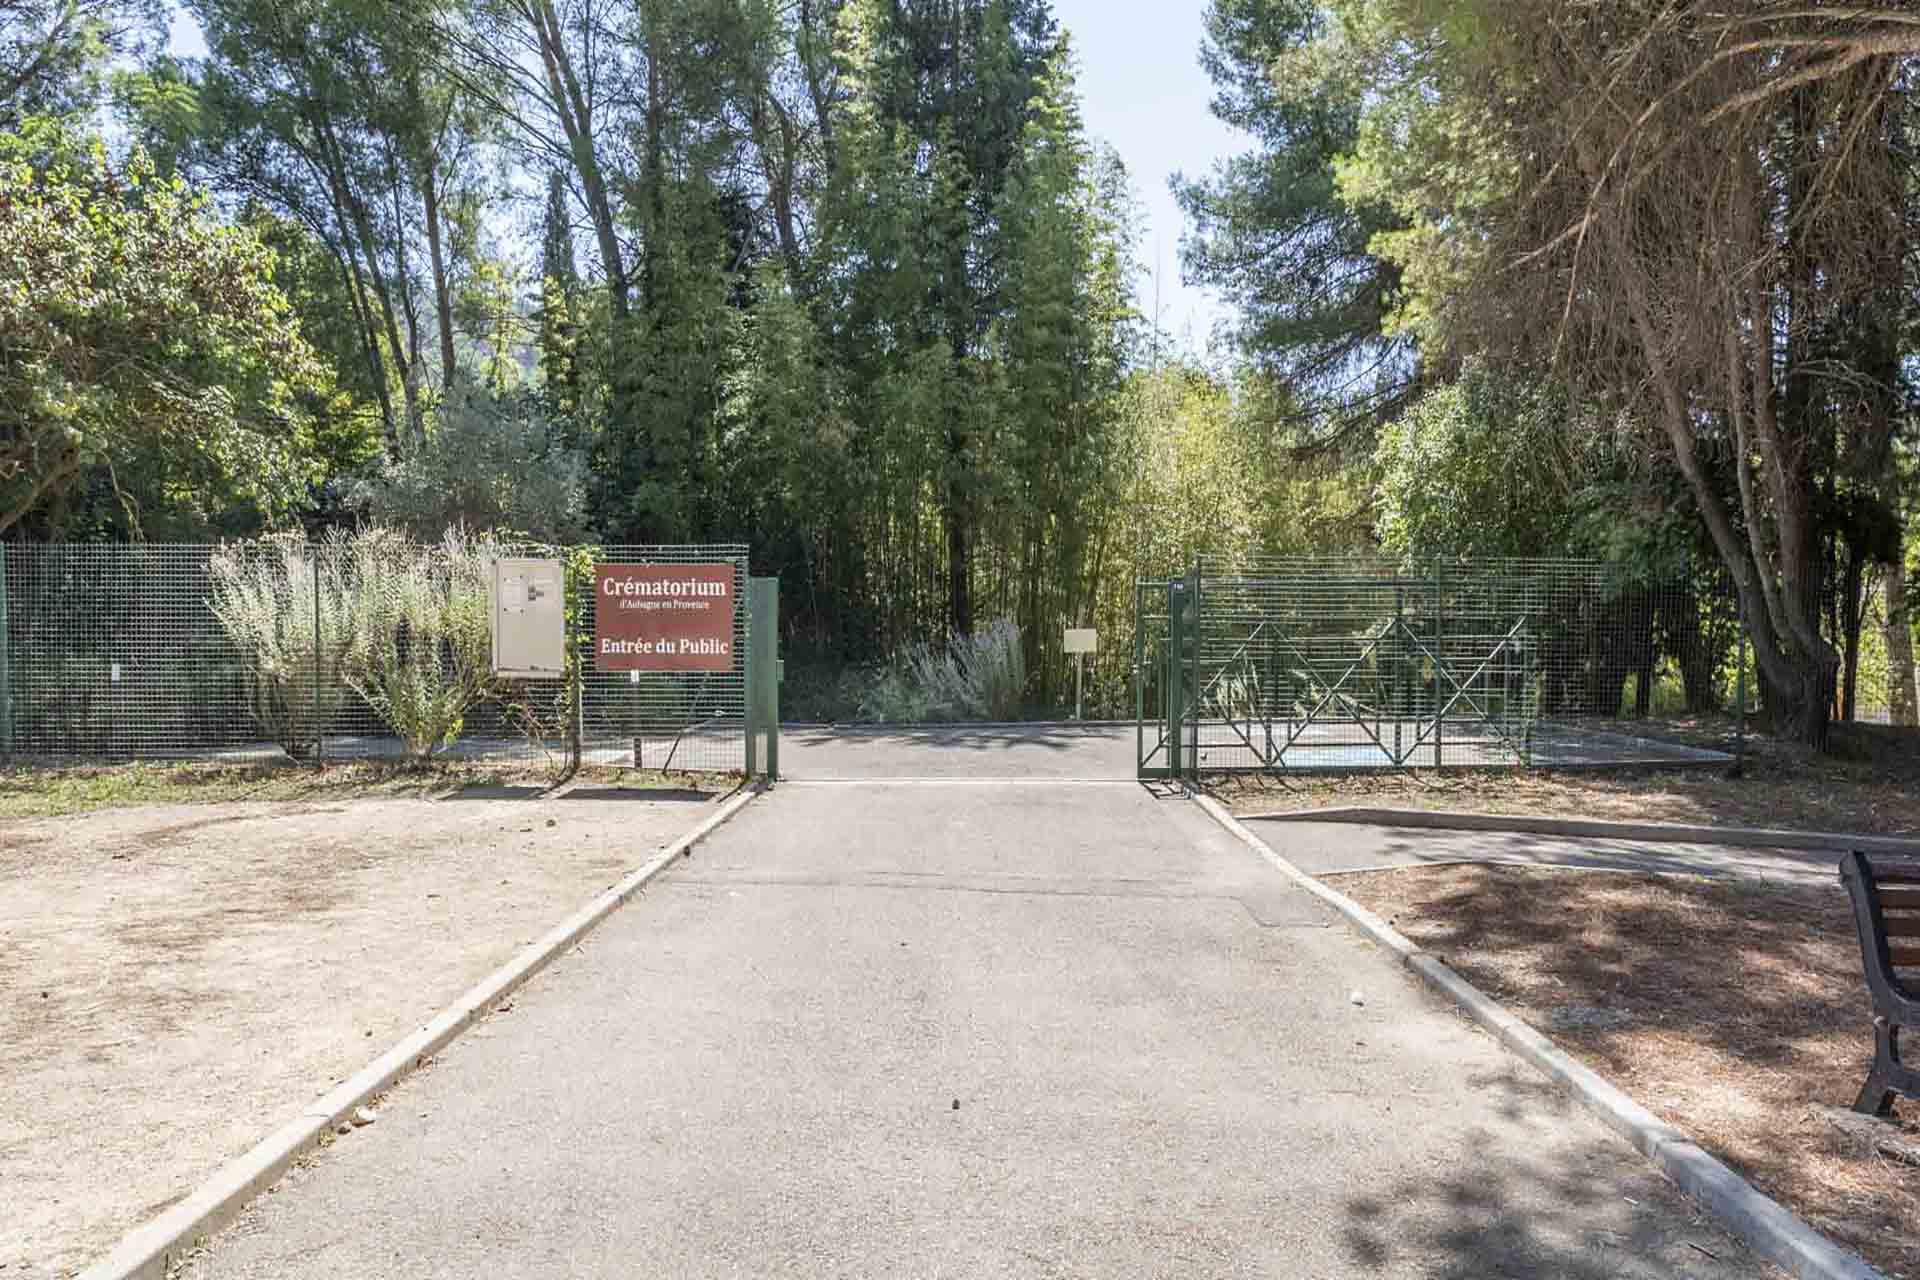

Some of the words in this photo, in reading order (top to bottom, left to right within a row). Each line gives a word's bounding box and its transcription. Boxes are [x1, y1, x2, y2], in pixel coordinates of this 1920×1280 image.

[603, 577, 726, 596] Crématorium
[601, 637, 652, 654] Entrée
[656, 638, 675, 654] du
[680, 638, 728, 654] Public
